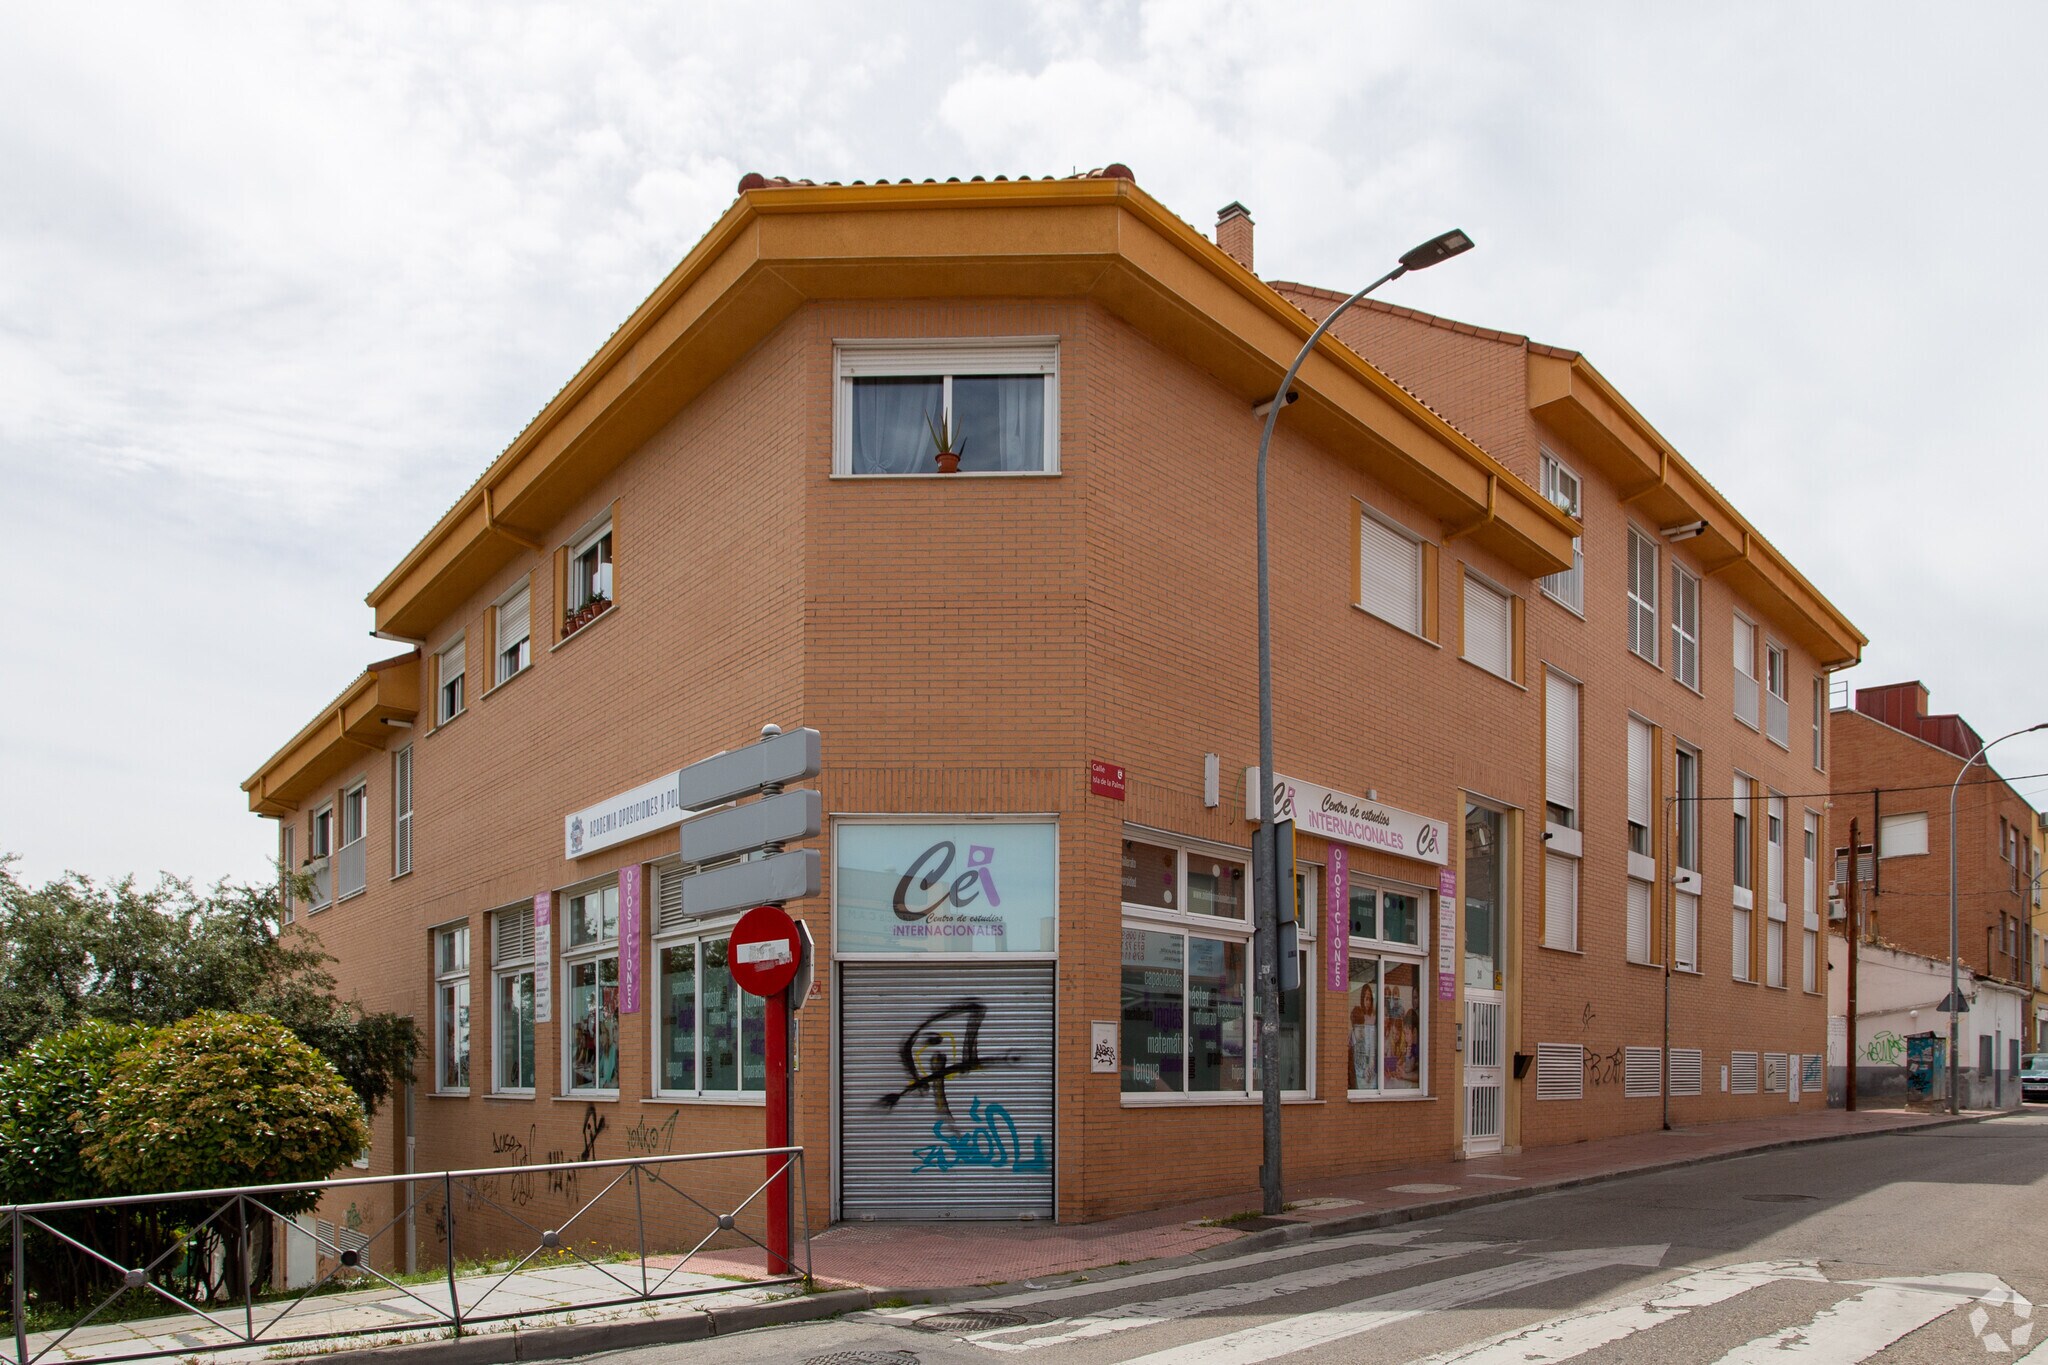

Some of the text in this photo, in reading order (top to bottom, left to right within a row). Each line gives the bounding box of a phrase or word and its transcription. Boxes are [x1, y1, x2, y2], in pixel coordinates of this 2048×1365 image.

[1092, 763, 1106, 773] Calle
[1101, 778, 1107, 786] de
[1111, 781, 1125, 790] Palma
[589, 788, 679, 838] ACADEMIA OPOSICIONES A POL
[1321, 793, 1390, 827] Centro de estudios
[925, 912, 1003, 925] Centro de estudios
[1334, 848, 1342, 988] OPOSICIONES
[1144, 969, 1183, 988] capacidades
[1147, 1032, 1194, 1054] matemátis
[1133, 1058, 1160, 1084] lengua
